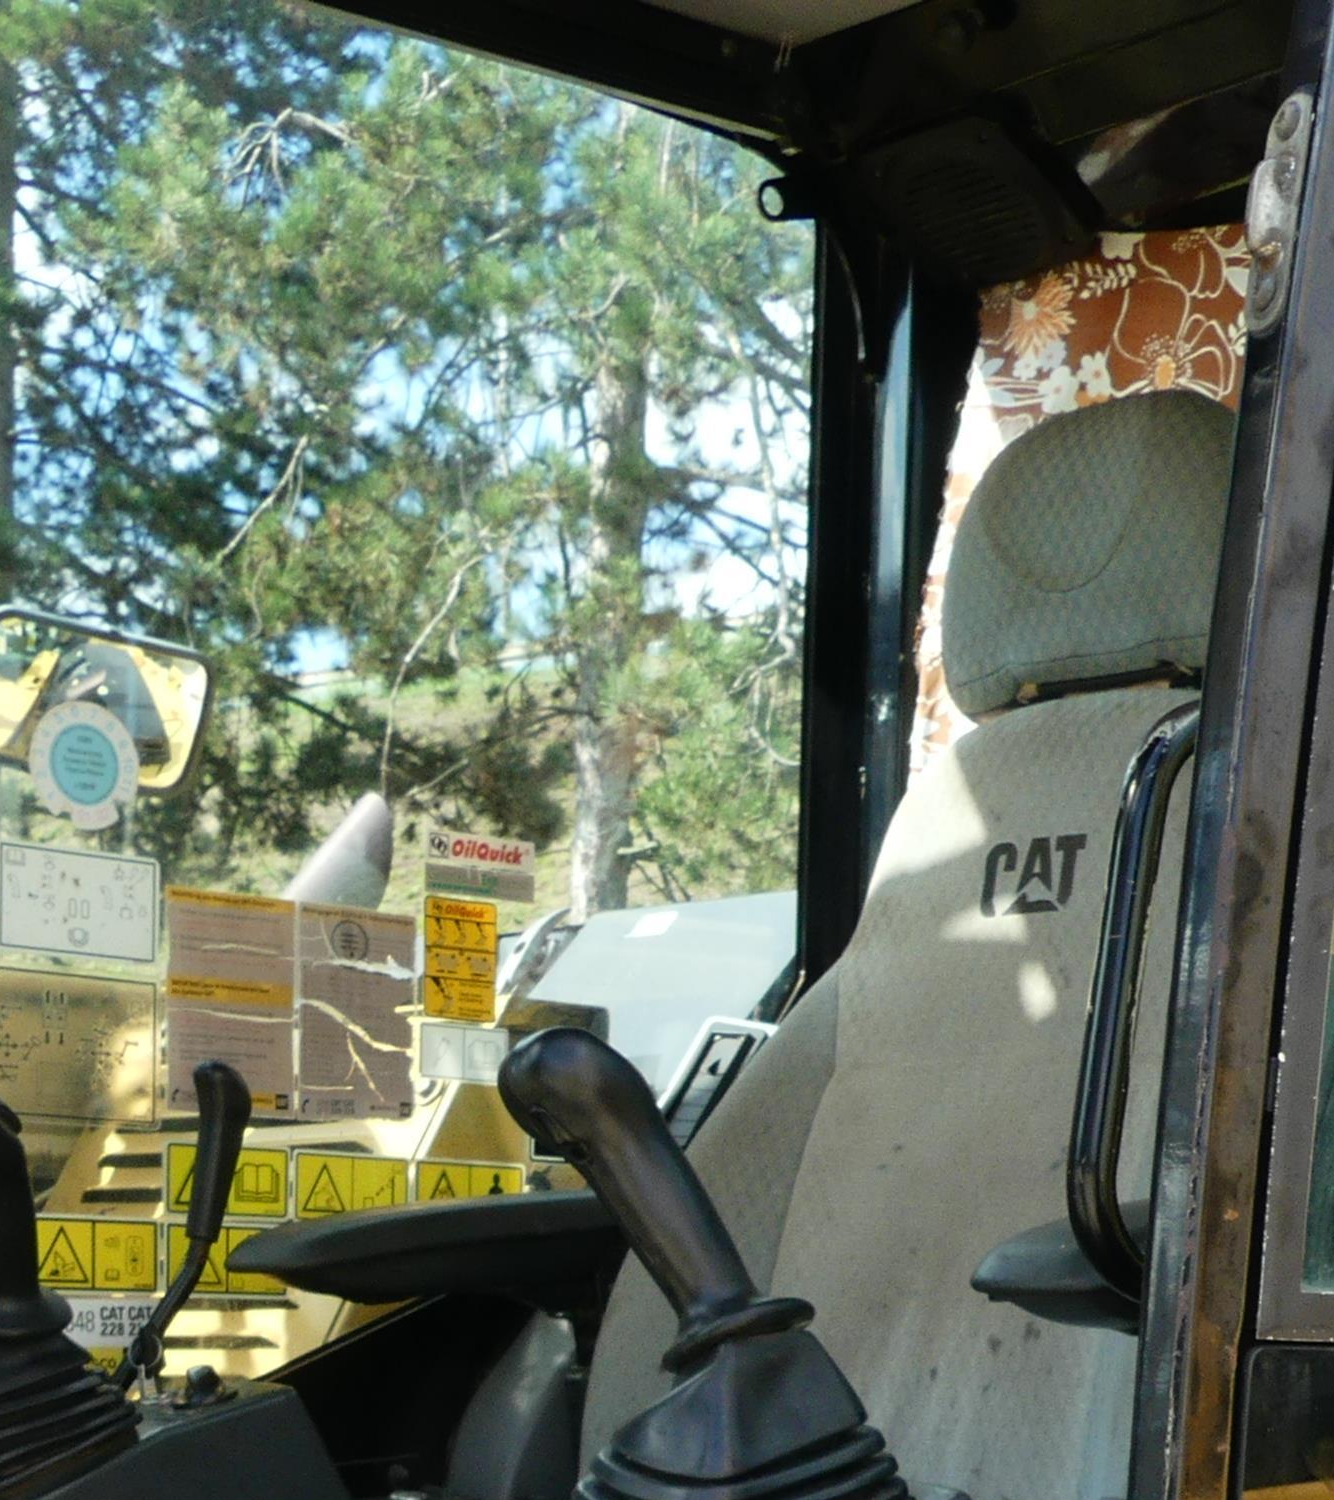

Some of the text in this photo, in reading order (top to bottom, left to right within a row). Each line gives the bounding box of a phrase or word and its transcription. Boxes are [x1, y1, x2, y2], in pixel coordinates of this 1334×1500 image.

[452, 839, 523, 865] OilQuick
[980, 834, 1087, 918] CAT
[100, 1306, 125, 1320] CAT
[100, 1322, 125, 1337] 228
